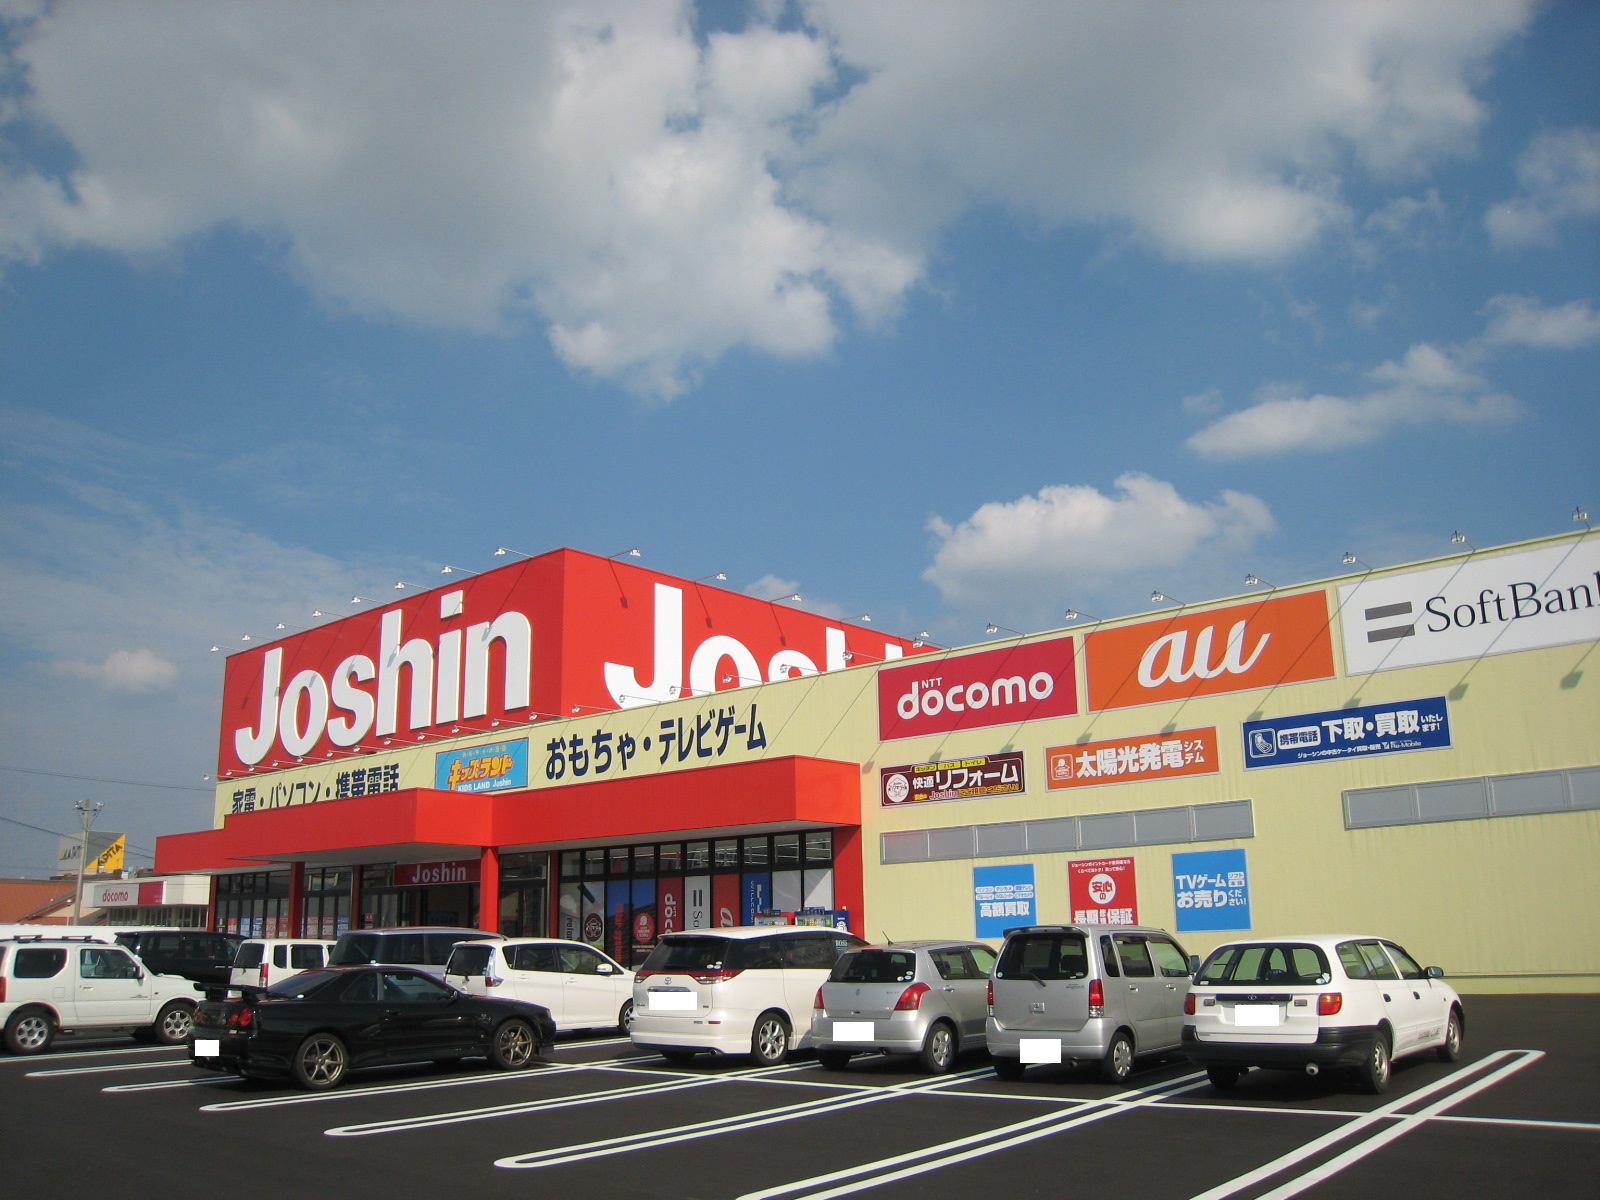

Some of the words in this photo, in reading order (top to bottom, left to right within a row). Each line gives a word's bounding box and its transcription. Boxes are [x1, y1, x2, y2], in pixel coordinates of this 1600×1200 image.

[1138, 619, 1271, 688] au
[235, 590, 531, 766] Joshin
[922, 677, 942, 689] NTT
[897, 672, 1054, 720] docomo
[1420, 713, 1443, 724] いたし
[1279, 729, 1318, 746] 携帯電話
[1322, 710, 1420, 743] 下取・買取
[545, 703, 767, 780] おもちゃ・テレビゲーム
[1184, 740, 1204, 752] シス
[1076, 740, 1184, 778] 太陽光発電
[1184, 752, 1205, 765] テム
[448, 754, 514, 791] キッズランド
[474, 781, 490, 790] LAND
[412, 862, 467, 883] Joshin
[1092, 881, 1113, 893] 安心
[1176, 874, 1227, 889] TVゲーム
[102, 889, 129, 902] docomo
[1099, 892, 1107, 900] の
[1177, 890, 1228, 908] お売り
[980, 901, 1030, 918] 高額買取
[1107, 908, 1133, 924] 保証
